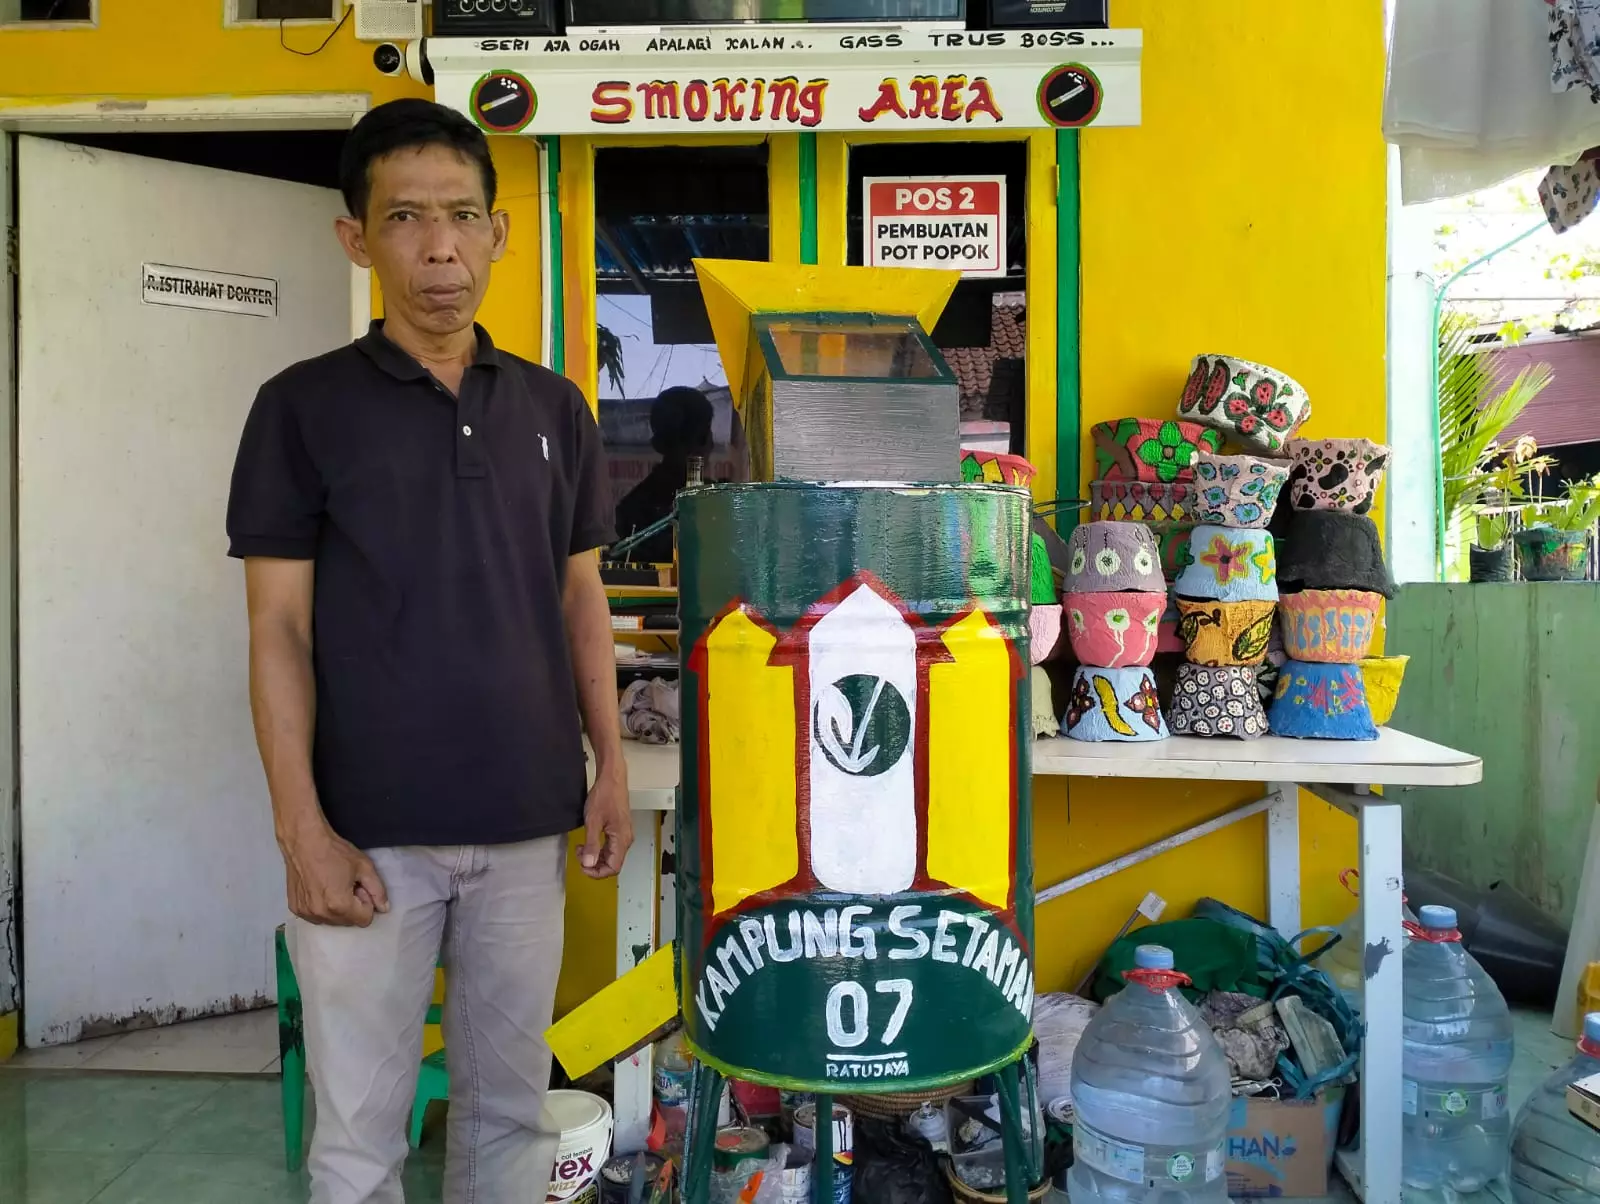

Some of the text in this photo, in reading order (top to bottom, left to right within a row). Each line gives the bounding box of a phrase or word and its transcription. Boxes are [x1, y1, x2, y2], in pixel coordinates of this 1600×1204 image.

[481, 38, 529, 51] SERI
[544, 39, 570, 52] AJA
[579, 39, 621, 52] OGAH
[840, 35, 903, 48] GASS
[928, 33, 1006, 47] TRUS
[858, 74, 1004, 123] AREA
[896, 187, 975, 211] POS 2
[878, 222, 988, 239] PEMBUATAN
[881, 244, 989, 260] POT POPOK
[227, 284, 273, 306] DOKTER
[695, 905, 1034, 1032] KAMPUNG SETAMAN
[825, 978, 913, 1048] 07
[826, 1061, 909, 1078] RATUJAYA
